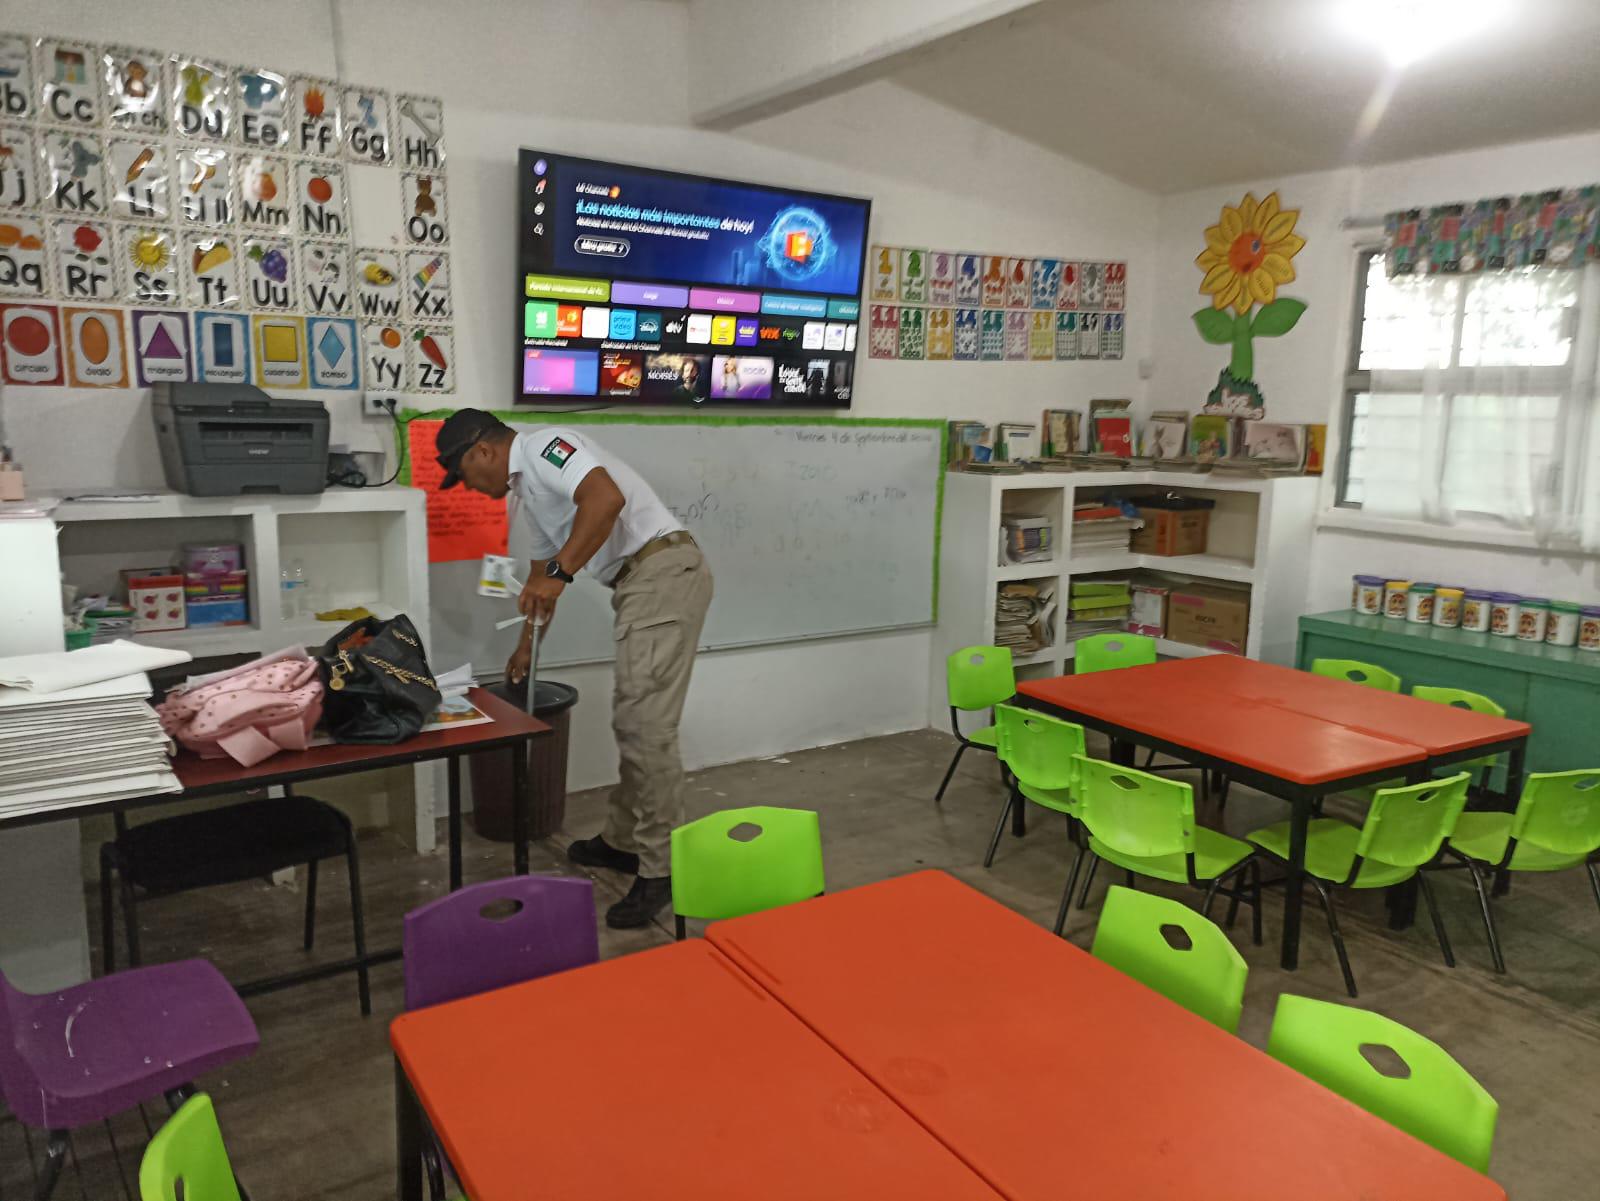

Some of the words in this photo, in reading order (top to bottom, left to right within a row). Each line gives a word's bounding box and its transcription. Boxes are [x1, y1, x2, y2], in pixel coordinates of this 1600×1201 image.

[0, 82, 26, 115] b
[51, 89, 94, 122] Cc
[242, 114, 278, 145] Ee
[301, 123, 332, 153] Ff
[351, 126, 386, 162] Gg
[405, 137, 438, 168] Hh
[55, 179, 99, 211] Kk
[242, 201, 290, 225] Mm
[302, 204, 341, 235] Nn
[599, 202, 641, 220] noticias
[641, 206, 663, 222] más
[663, 210, 720, 229] importantes
[720, 218, 733, 231] de
[408, 216, 444, 243] Oo
[879, 247, 892, 274] 1
[907, 250, 921, 278] 2
[961, 254, 976, 279] 4
[1042, 259, 1058, 284] 7
[66, 265, 107, 296] Rr
[133, 271, 169, 301] Ss
[197, 277, 228, 305] Tt
[252, 279, 288, 308] Uu
[308, 283, 347, 312] Vv
[359, 292, 400, 316] Ww
[412, 289, 447, 316] Xx
[871, 304, 898, 329] 11
[901, 309, 922, 328] 12
[956, 309, 977, 329] 14
[371, 356, 402, 389] Yy
[418, 363, 446, 388] Zz
